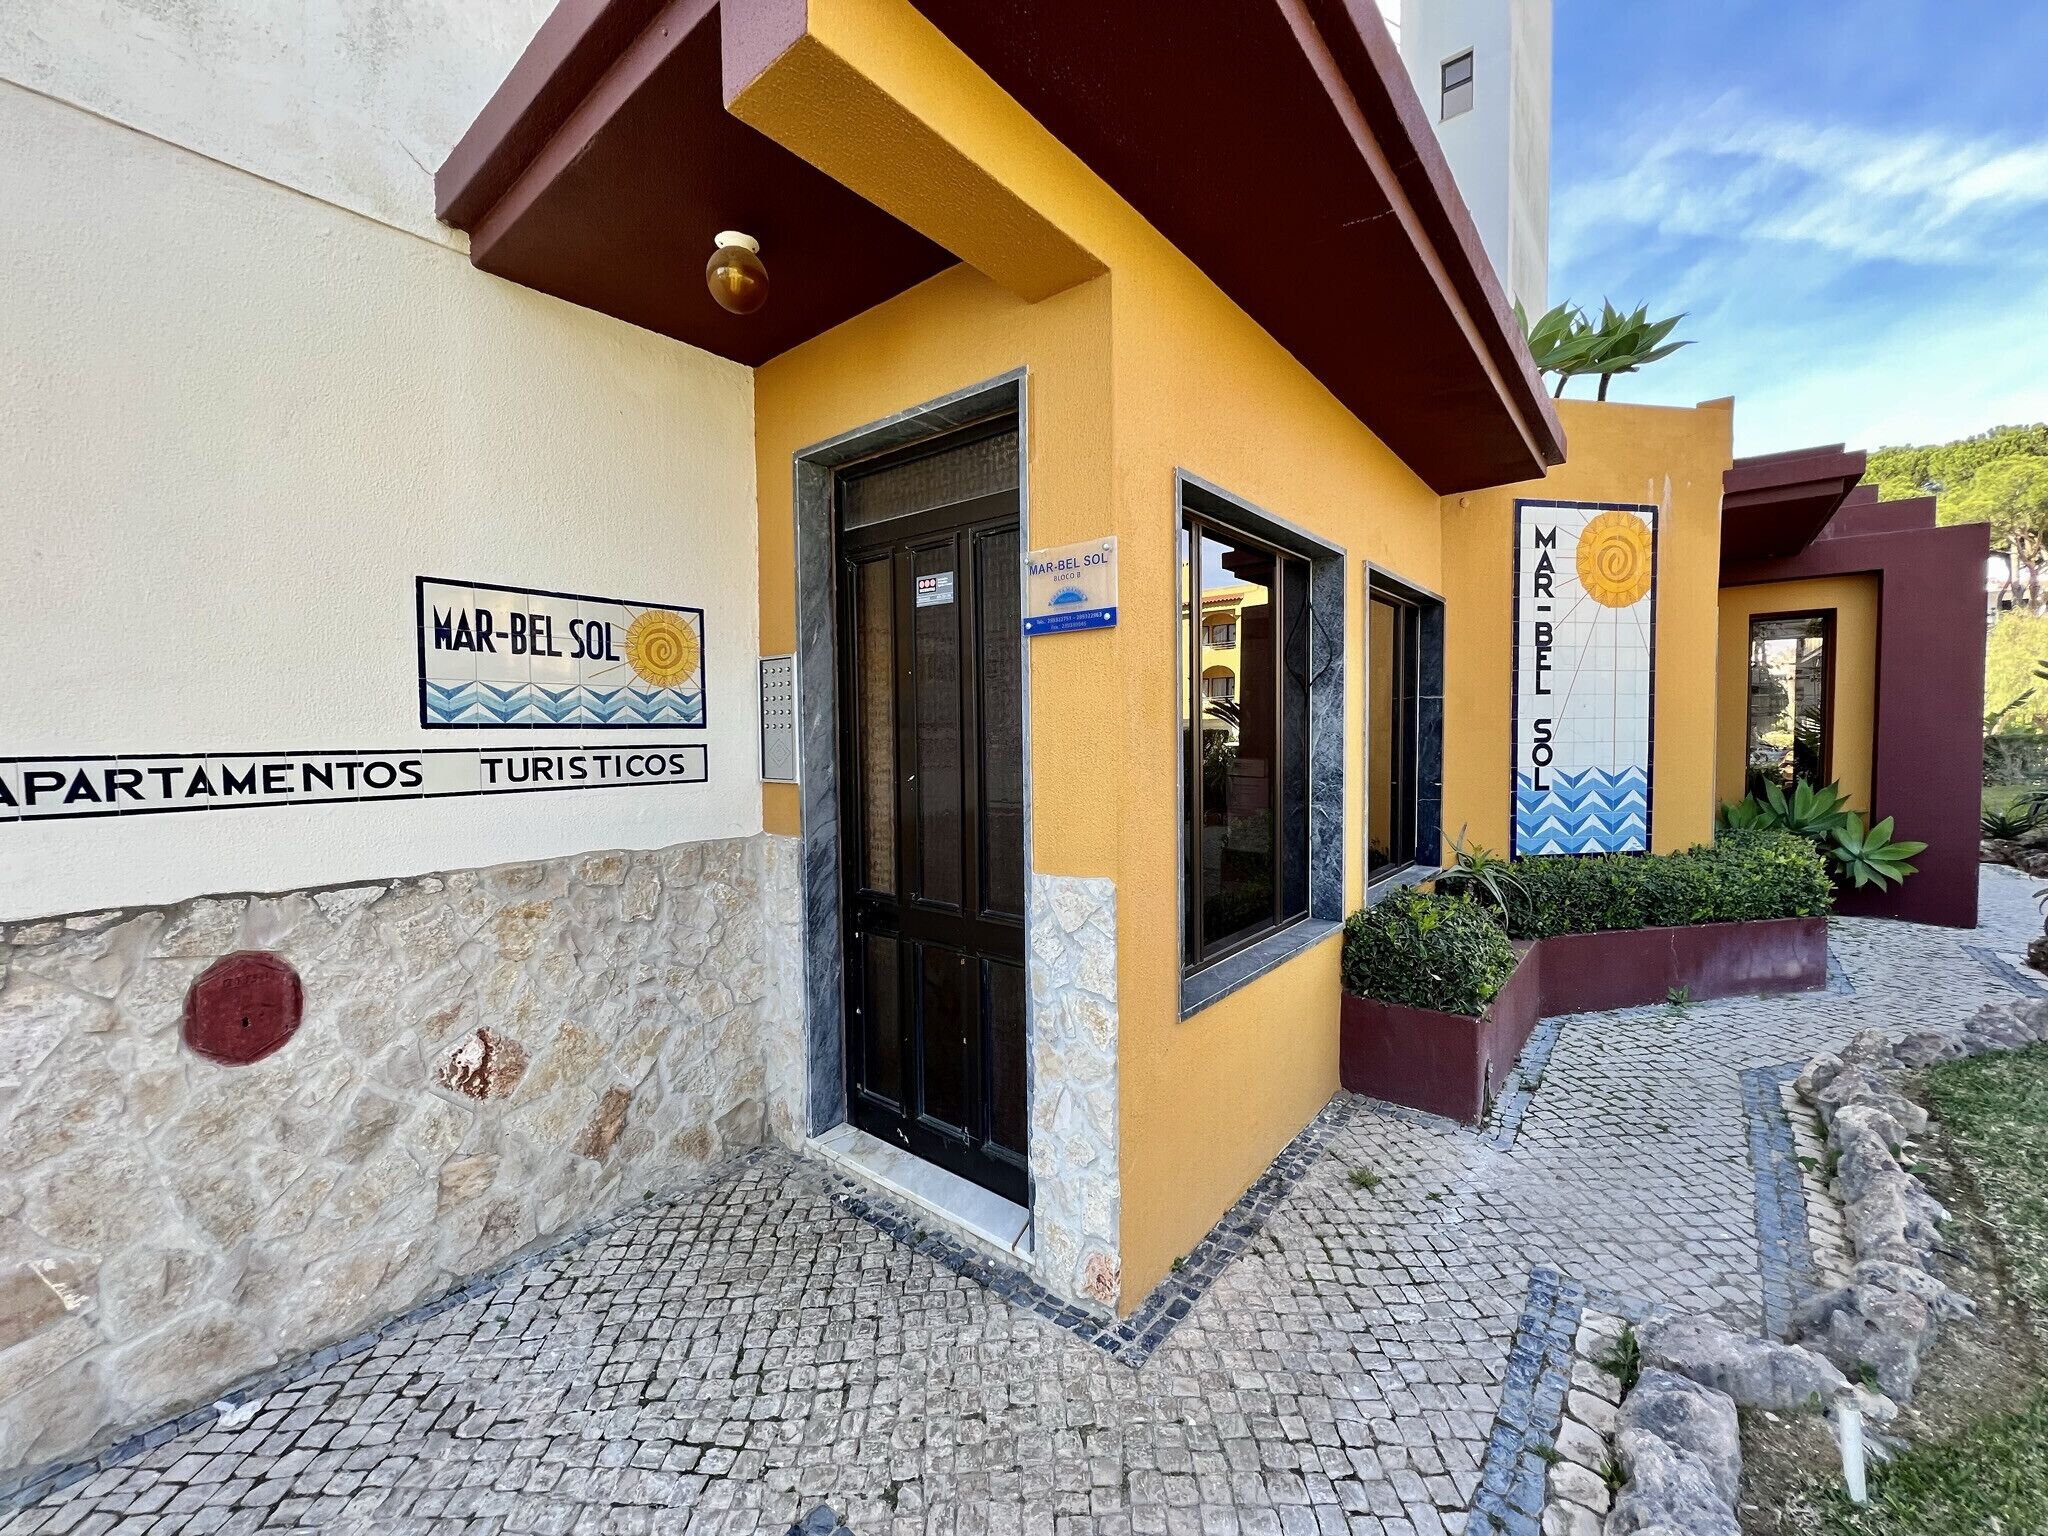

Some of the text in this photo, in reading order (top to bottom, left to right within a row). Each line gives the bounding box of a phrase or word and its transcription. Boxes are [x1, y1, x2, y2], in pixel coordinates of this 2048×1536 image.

[1029, 552, 1108, 576] MAR-BEL SOL
[1053, 572, 1075, 582] BLOCO
[433, 604, 620, 662] MAR-BEL SOL
[1531, 524, 1557, 792] MAR-BEL SOL
[480, 753, 685, 784] TURISTICOS
